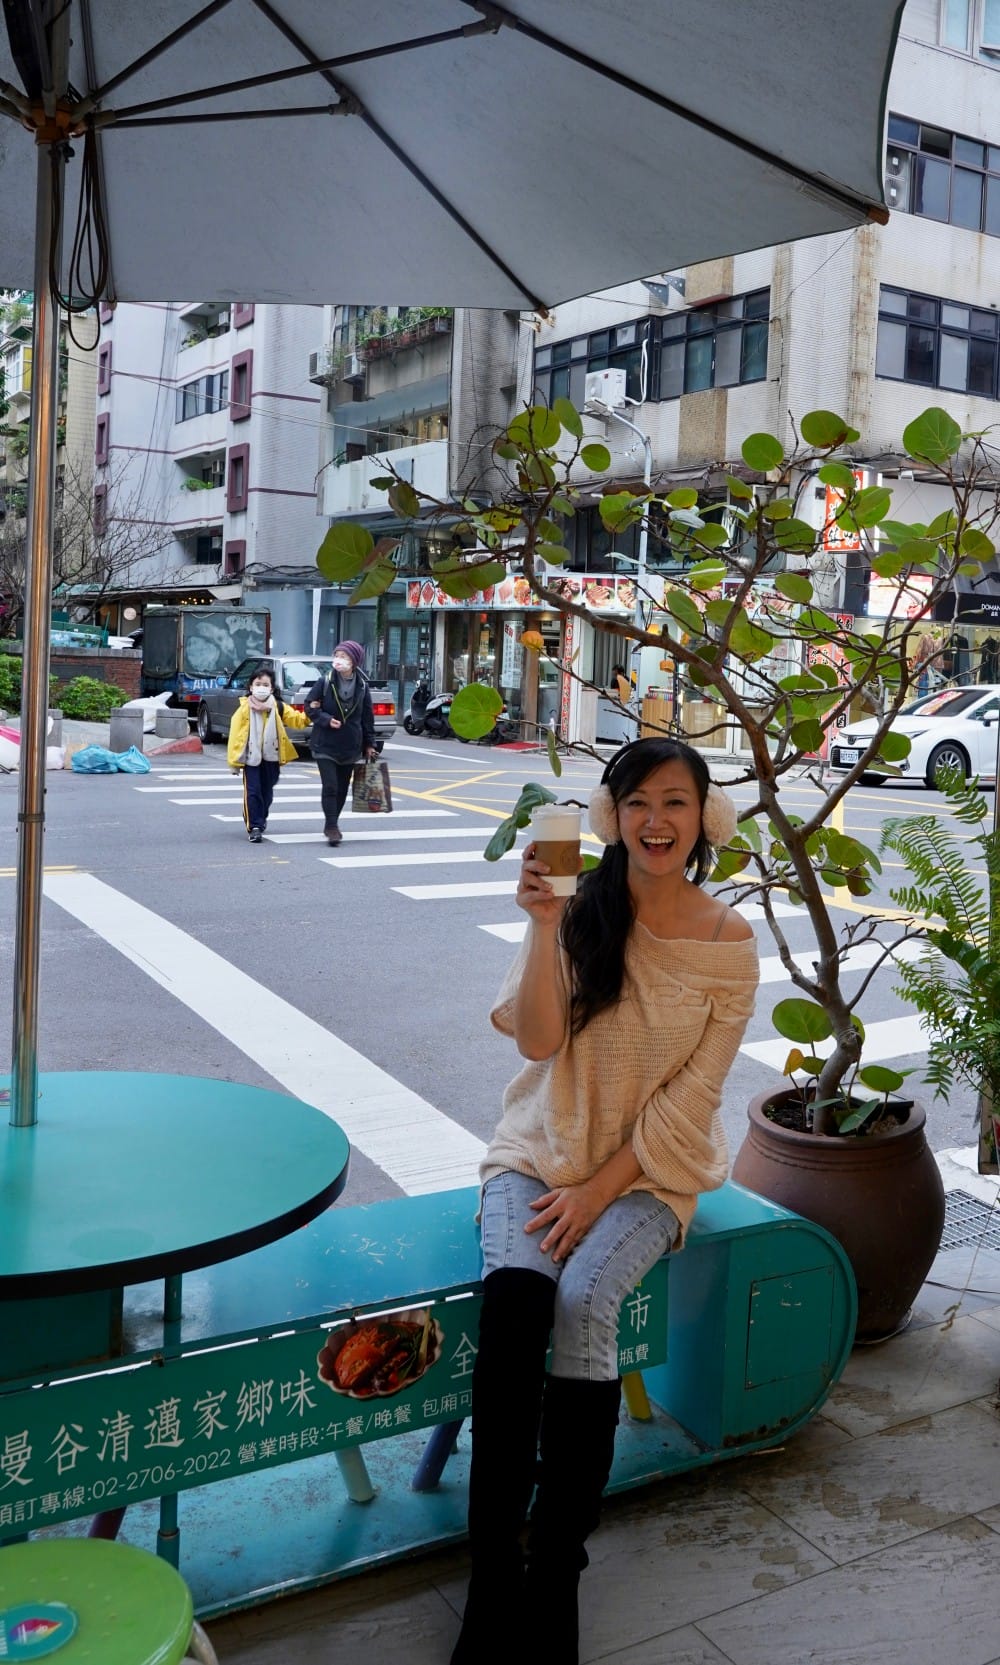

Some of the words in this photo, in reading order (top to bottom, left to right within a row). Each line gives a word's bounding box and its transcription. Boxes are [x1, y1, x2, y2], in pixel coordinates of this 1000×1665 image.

[0, 1369, 317, 1490] 曼谷清邁家鄉味
